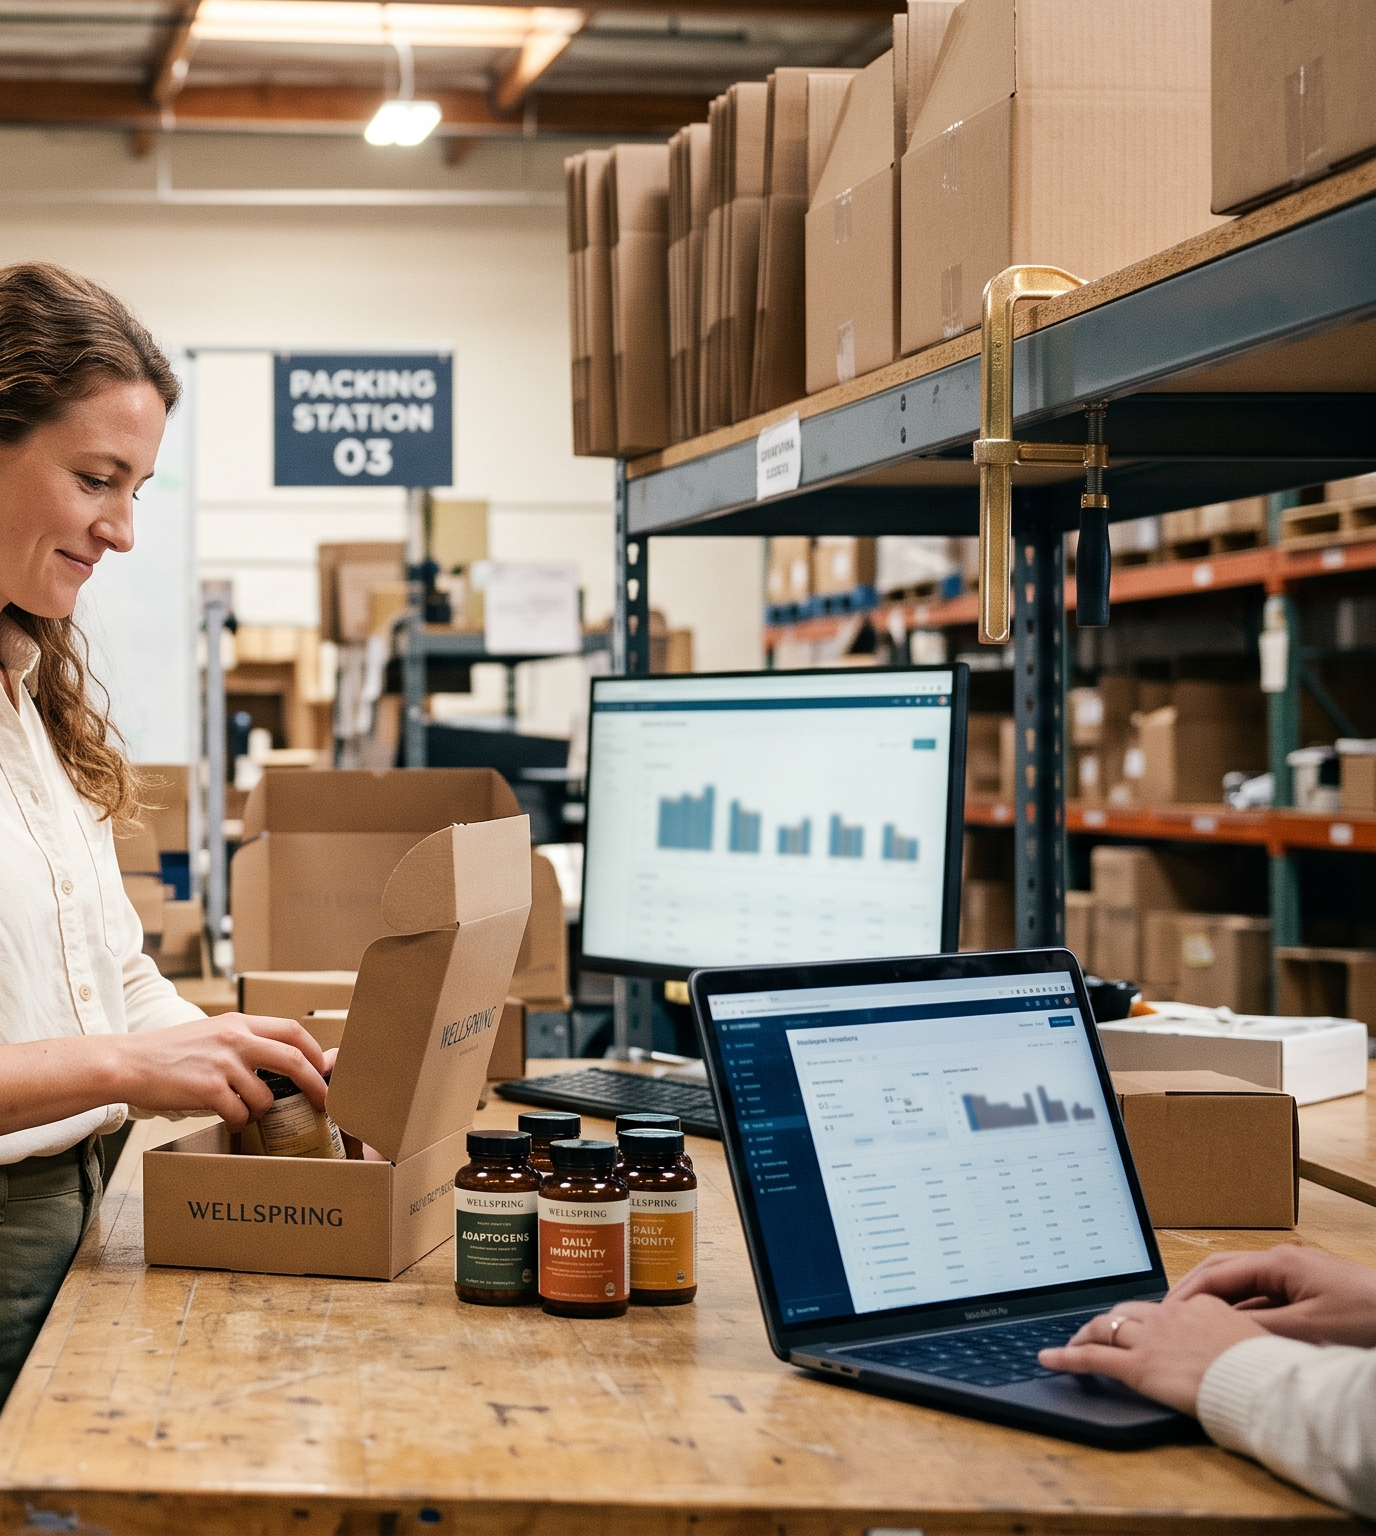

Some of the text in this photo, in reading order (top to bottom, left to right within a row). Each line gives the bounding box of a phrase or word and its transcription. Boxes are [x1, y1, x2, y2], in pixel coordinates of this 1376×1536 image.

[289, 369, 436, 399] PACKING
[292, 402, 434, 433] STATION
[333, 437, 394, 477] 03
[466, 1198, 524, 1208] WELLSPRING
[549, 1207, 607, 1218] WELLSPRING
[187, 1200, 343, 1227] WELLSPRING
[562, 1237, 593, 1247] DAILY
[550, 1246, 606, 1258] IMMUNITY
